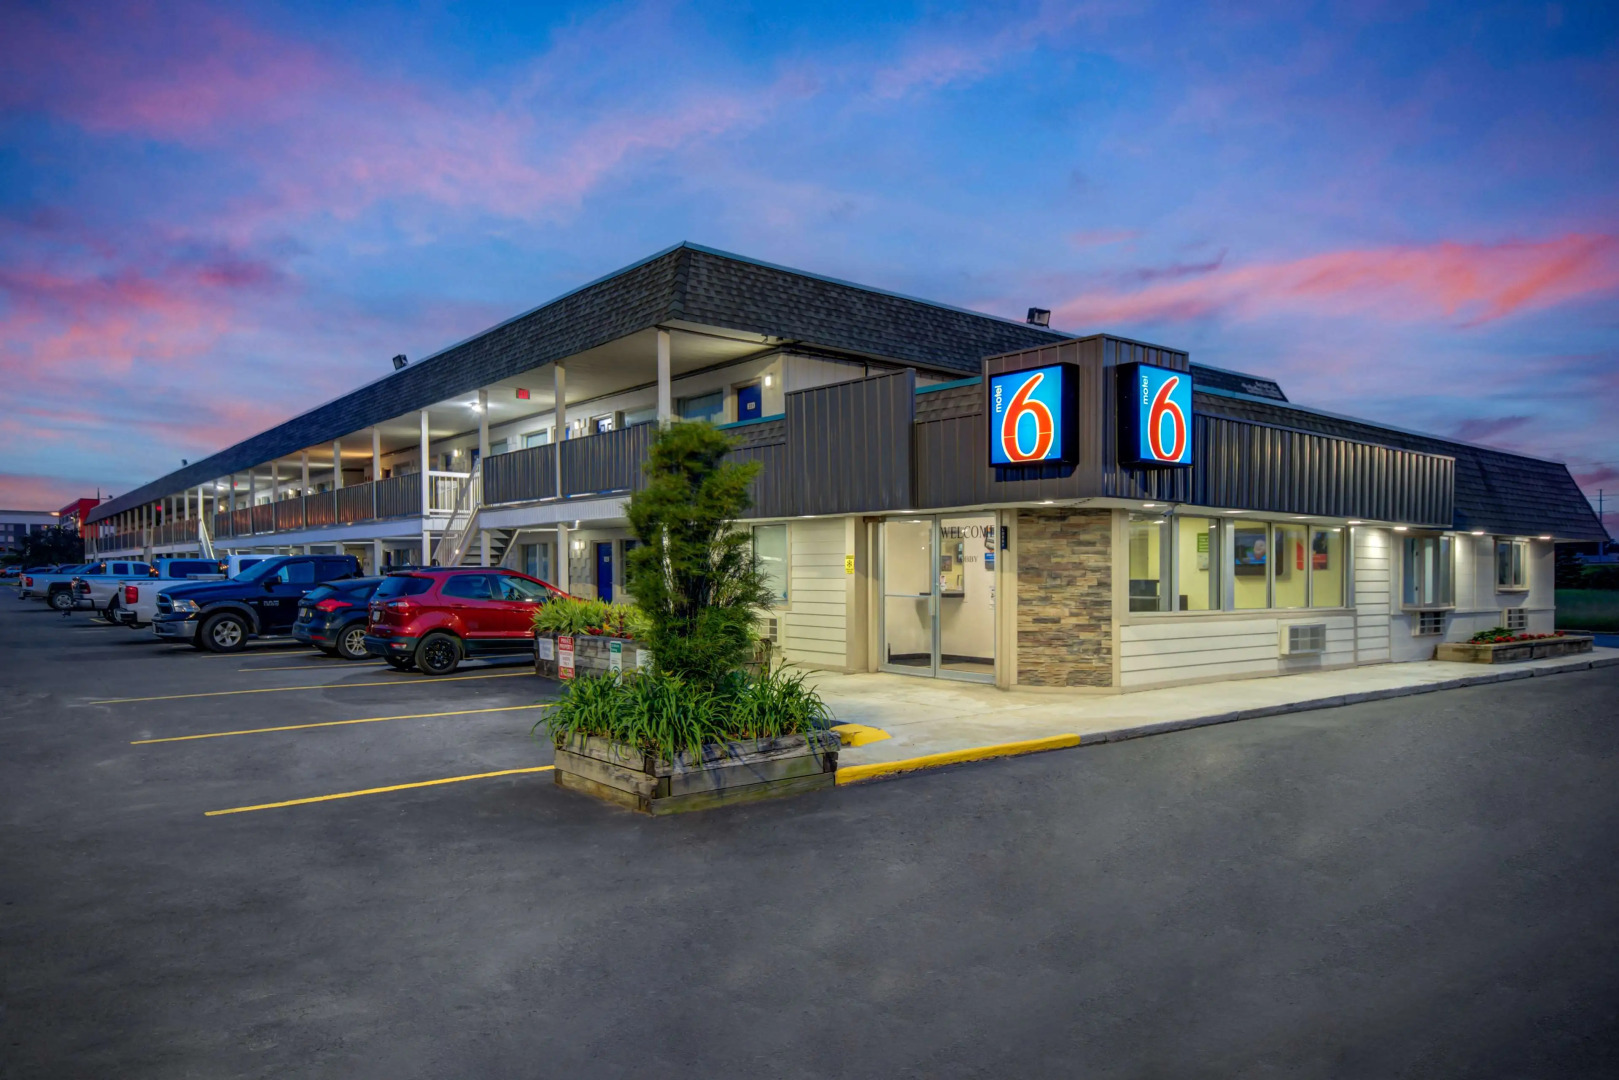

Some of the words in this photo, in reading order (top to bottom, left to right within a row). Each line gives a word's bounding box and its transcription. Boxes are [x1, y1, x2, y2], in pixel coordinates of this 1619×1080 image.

[1001, 373, 1054, 462] 6
[1148, 376, 1186, 462] 6
[940, 525, 995, 539] WELCOME
